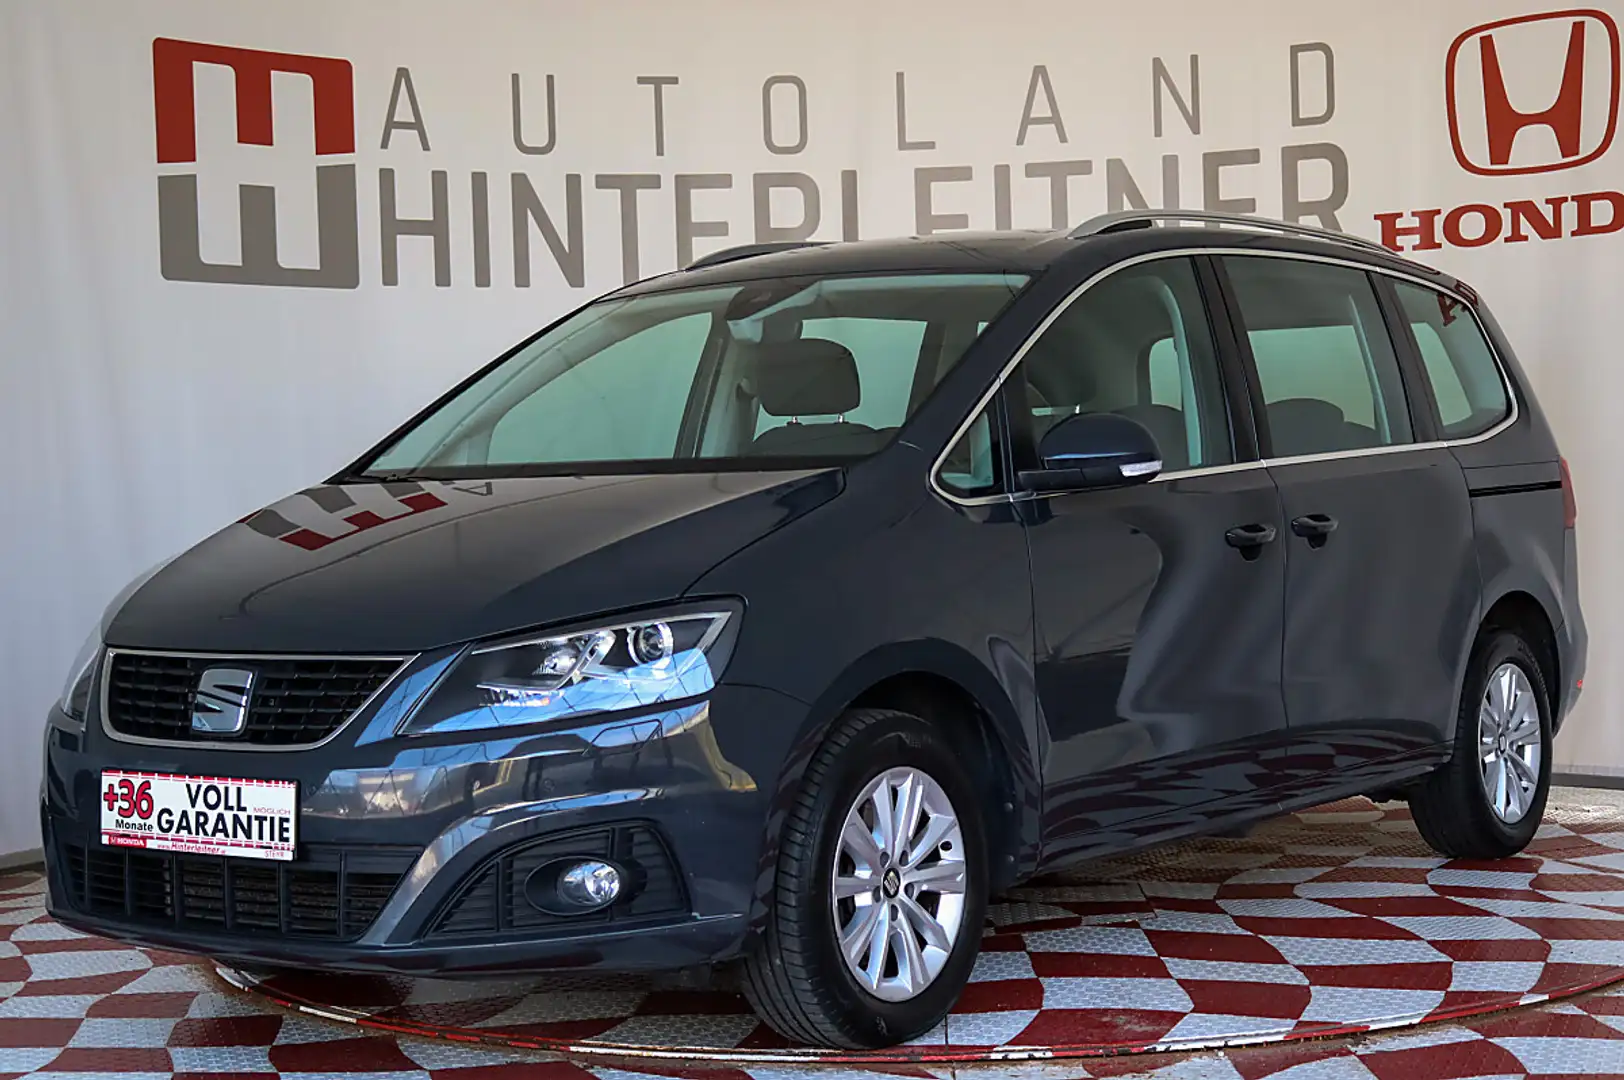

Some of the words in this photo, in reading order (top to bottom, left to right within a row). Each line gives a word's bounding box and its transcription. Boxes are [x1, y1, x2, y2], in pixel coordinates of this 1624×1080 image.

[380, 42, 1335, 157] AUTOLAND
[103, 778, 154, 820] +36
[186, 783, 247, 812] VOLL
[115, 818, 153, 832] Monate
[157, 808, 290, 843] GARANTIE
[116, 838, 145, 846] HONDA
